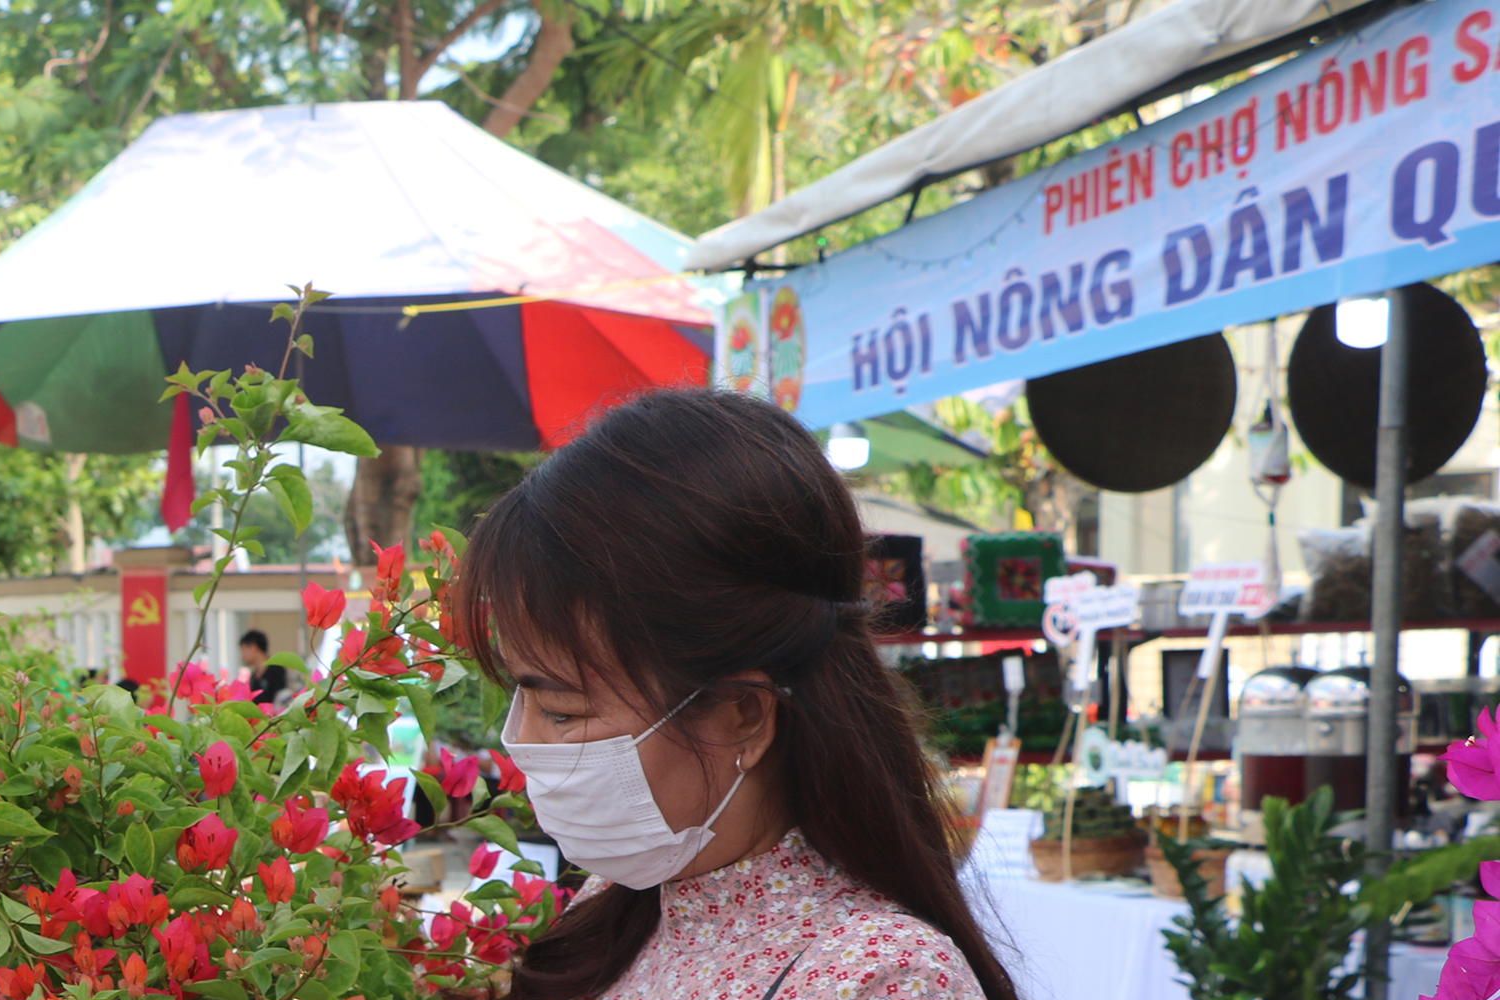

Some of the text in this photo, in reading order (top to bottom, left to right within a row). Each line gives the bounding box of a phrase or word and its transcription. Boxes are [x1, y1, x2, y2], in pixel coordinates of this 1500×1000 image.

[1044, 9, 1500, 235] PHIÊN CHỢ NÔNG S
[851, 304, 933, 395] HỘI
[951, 248, 1135, 366] NÔNG
[1162, 173, 1349, 306] DÂN
